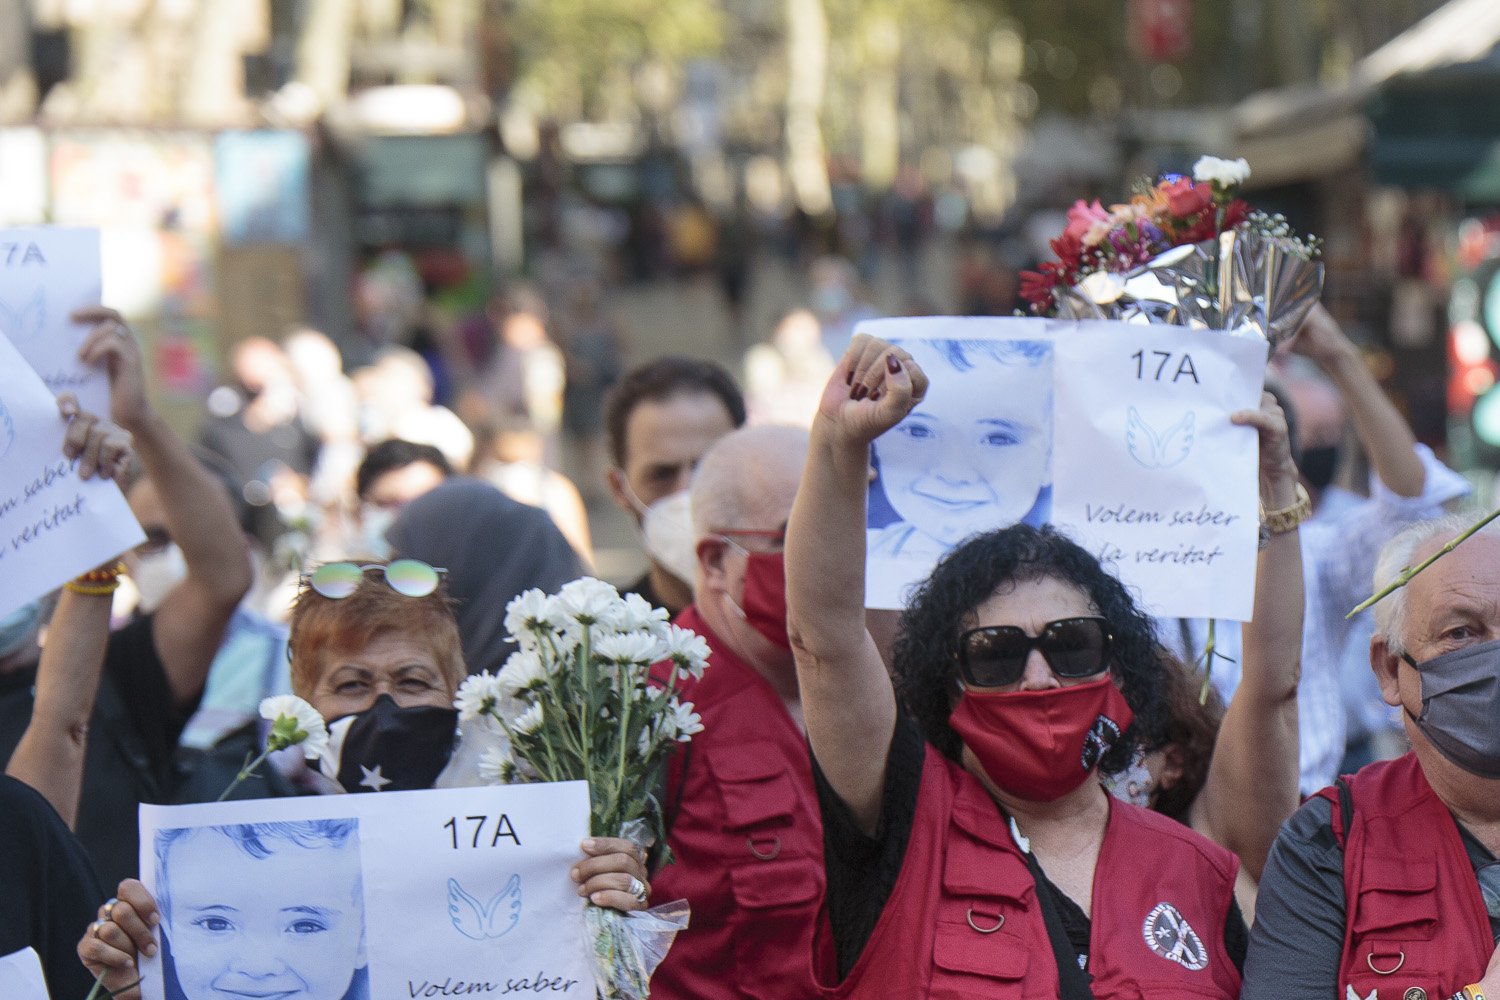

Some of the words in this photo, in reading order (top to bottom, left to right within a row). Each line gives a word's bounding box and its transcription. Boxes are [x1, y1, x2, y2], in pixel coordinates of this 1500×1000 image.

[0, 241, 47, 267] 7A
[1131, 349, 1201, 385] 17A
[11, 493, 86, 550] veritat
[1085, 503, 1165, 523] Volem
[1168, 504, 1240, 527] saber
[1135, 543, 1223, 565] veritat
[444, 814, 521, 849] 17A
[408, 977, 499, 999] Volem
[501, 971, 579, 995] saber
